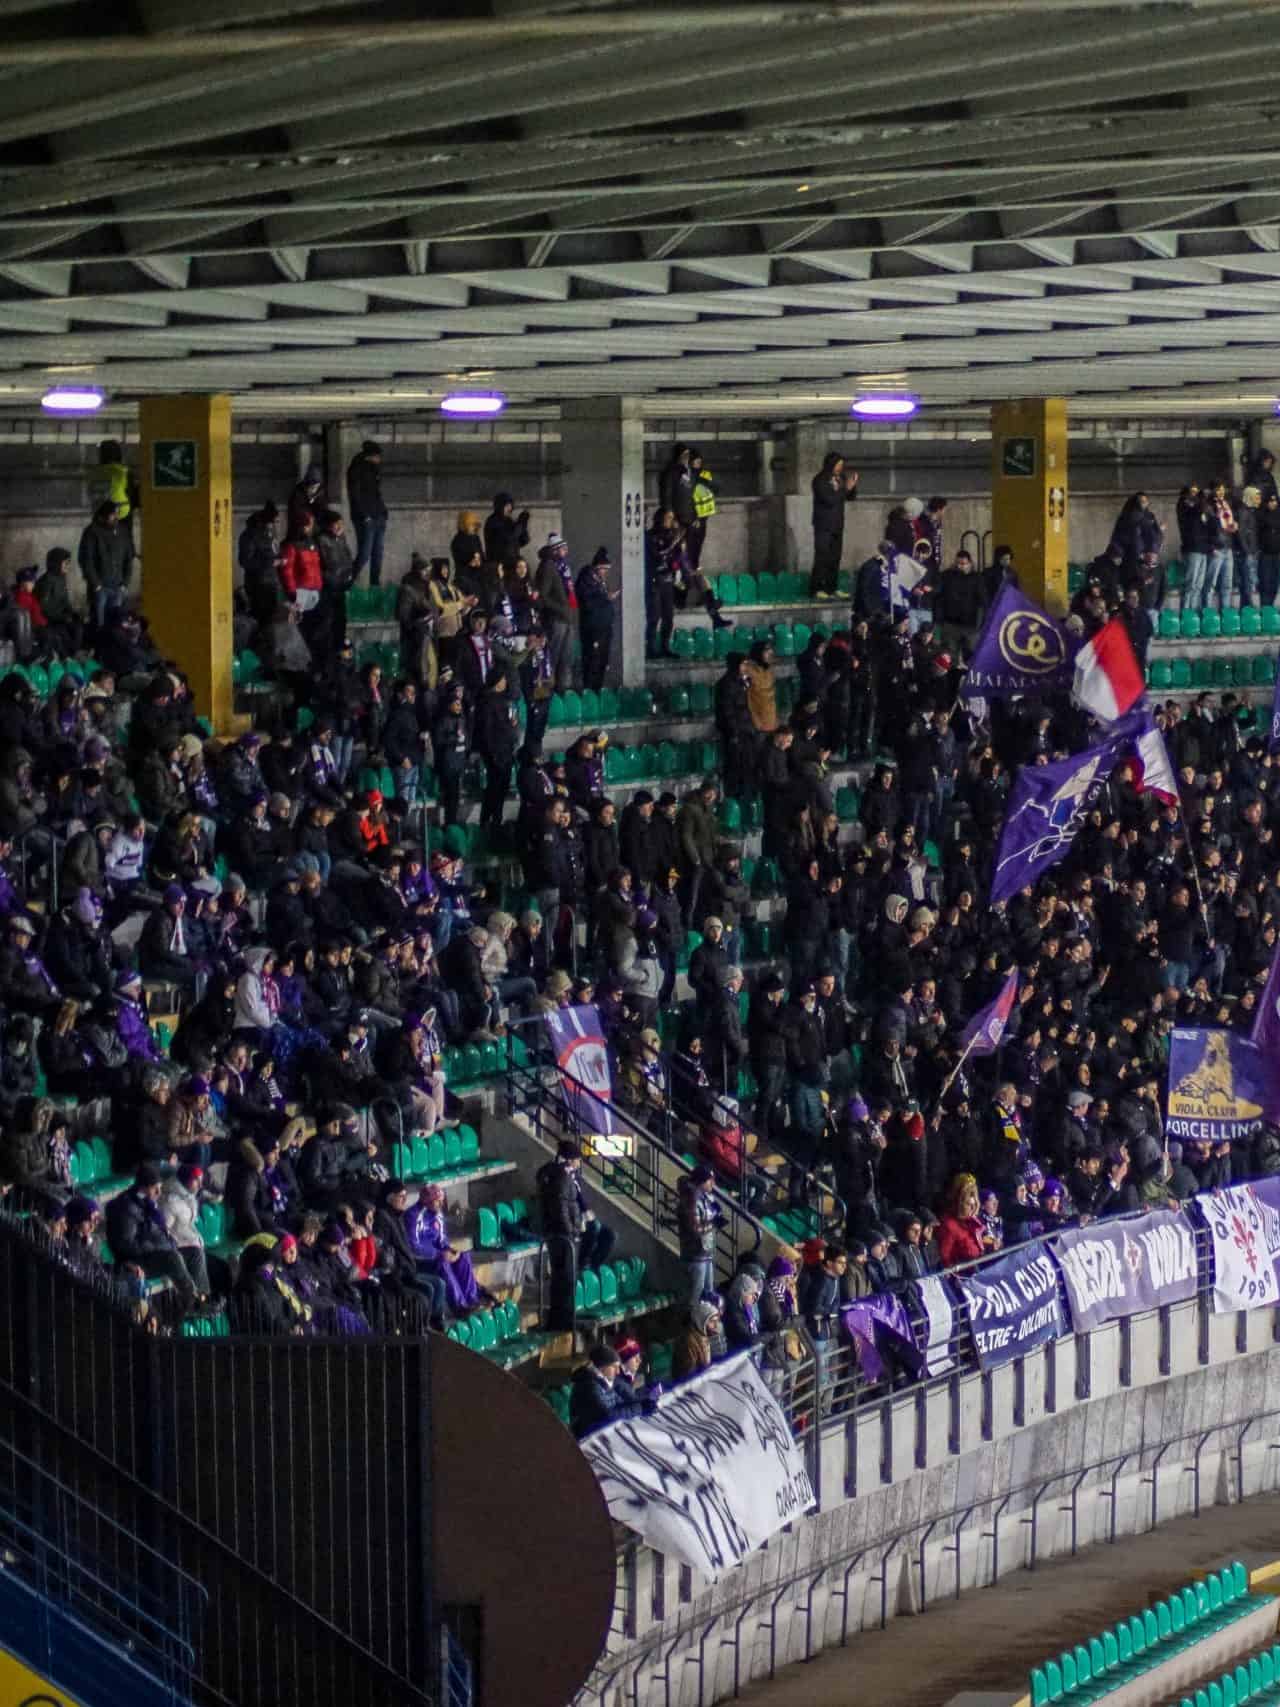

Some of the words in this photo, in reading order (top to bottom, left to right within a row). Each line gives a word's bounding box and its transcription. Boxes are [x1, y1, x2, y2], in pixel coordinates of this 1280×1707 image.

[1175, 1103, 1203, 1115] VIOLA
[1207, 1105, 1238, 1117] CLUB
[962, 1279, 1021, 1321] VIOLA
[1014, 1255, 1057, 1302] CLUB
